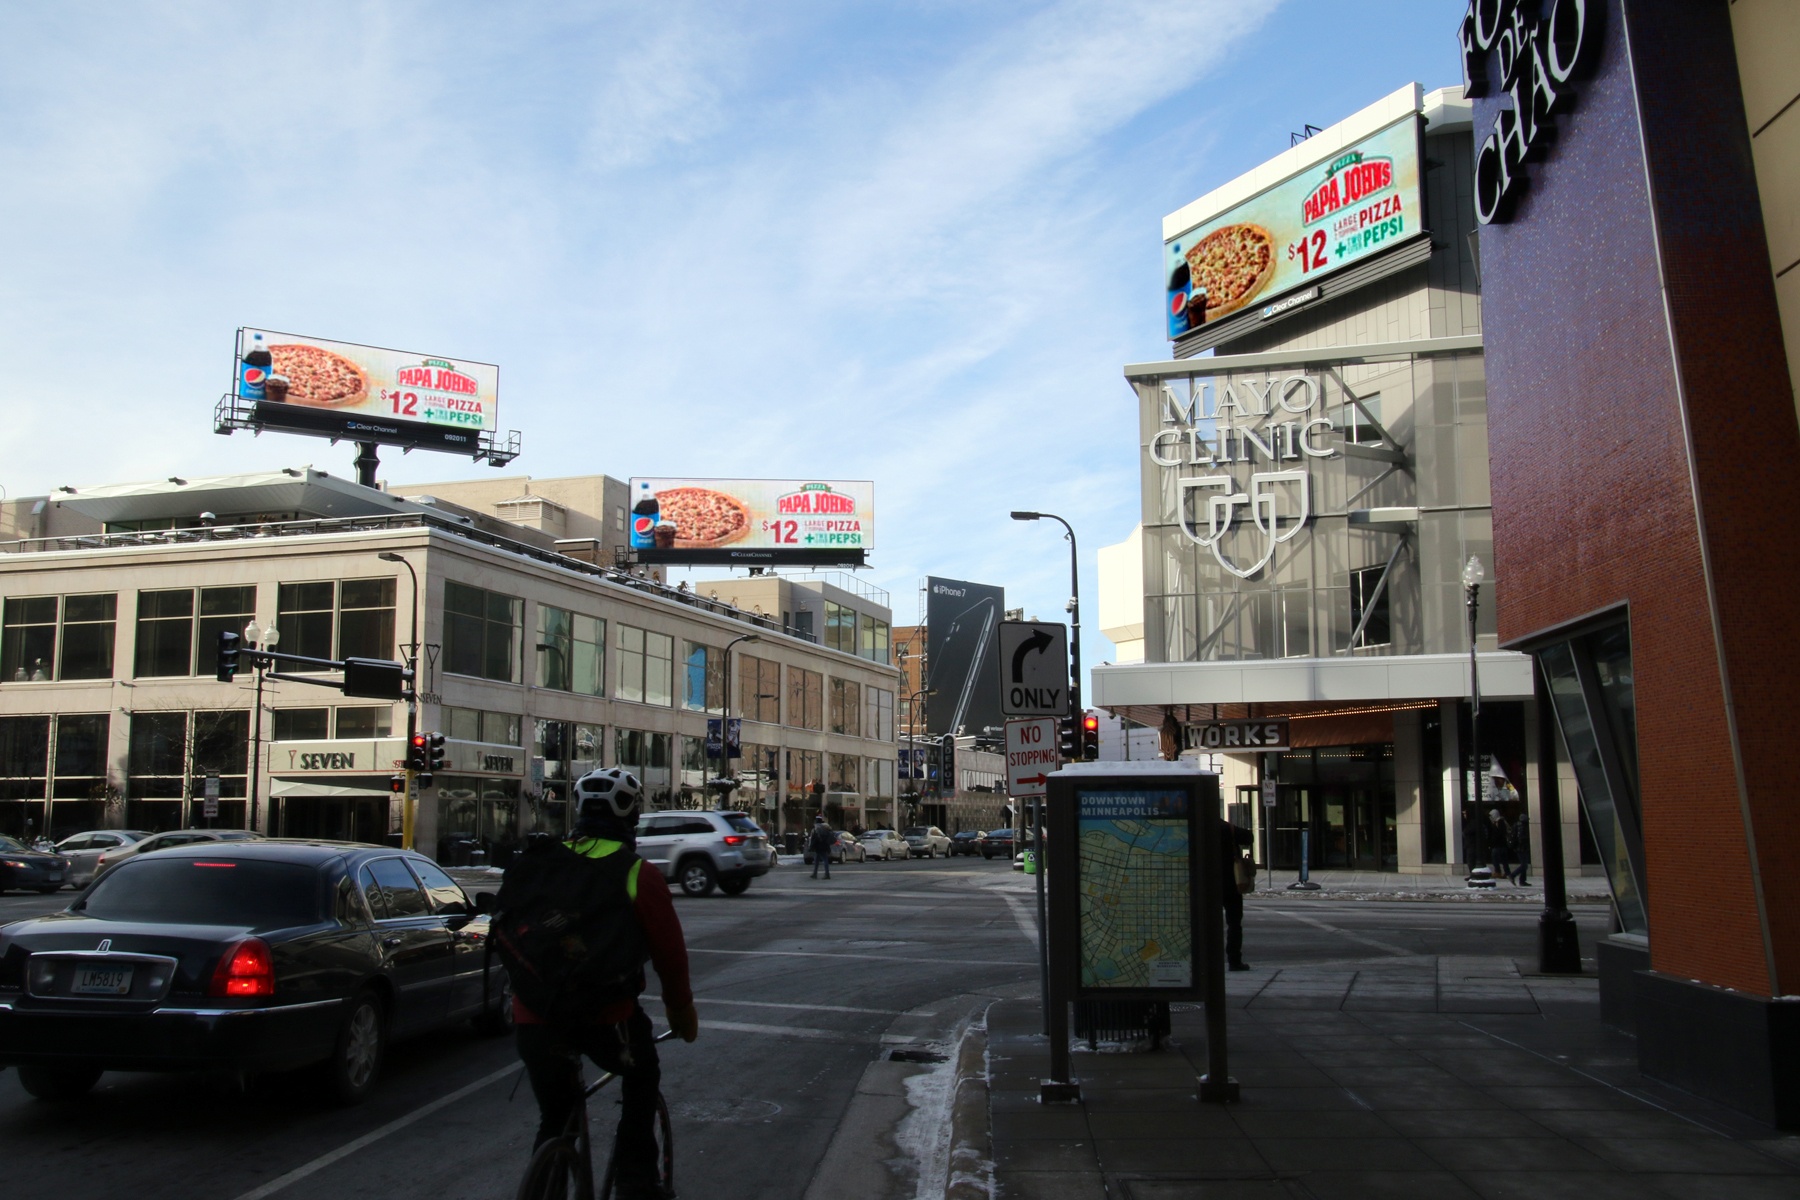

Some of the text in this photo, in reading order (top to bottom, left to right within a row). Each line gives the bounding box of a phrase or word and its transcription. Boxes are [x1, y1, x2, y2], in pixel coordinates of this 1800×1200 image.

[1304, 176, 1341, 223] PAPA
[1359, 194, 1402, 229] PIZZA
[1363, 215, 1403, 248] PEPSI
[1288, 229, 1328, 273] $12
[1272, 290, 1312, 313] Clear Channel
[399, 368, 432, 389] PAPA
[380, 389, 418, 417] $12
[447, 398, 482, 413] PIZZA
[1161, 374, 1317, 424] MAYO
[356, 423, 398, 433] Clear Channel
[450, 411, 482, 425] PEPSI
[1148, 417, 1335, 467] CLINIC
[779, 493, 811, 514] PAPA
[762, 519, 798, 544] $12
[826, 520, 861, 532] PIZZA
[829, 533, 861, 544] PEPSI
[939, 585, 967, 598] iPhone 7
[1010, 688, 1061, 709] ONLY
[1020, 725, 1042, 745] NO
[1187, 724, 1280, 747] WORKS
[300, 752, 355, 770] SEVEN
[483, 754, 514, 772] SEVEN
[944, 746, 953, 786] DEPOT
[1009, 748, 1055, 767] STOPPING
[1081, 796, 1146, 805] DOWNTOWN
[1081, 807, 1160, 816] MINNEAPOLIS
[82, 971, 124, 987] LM5819
